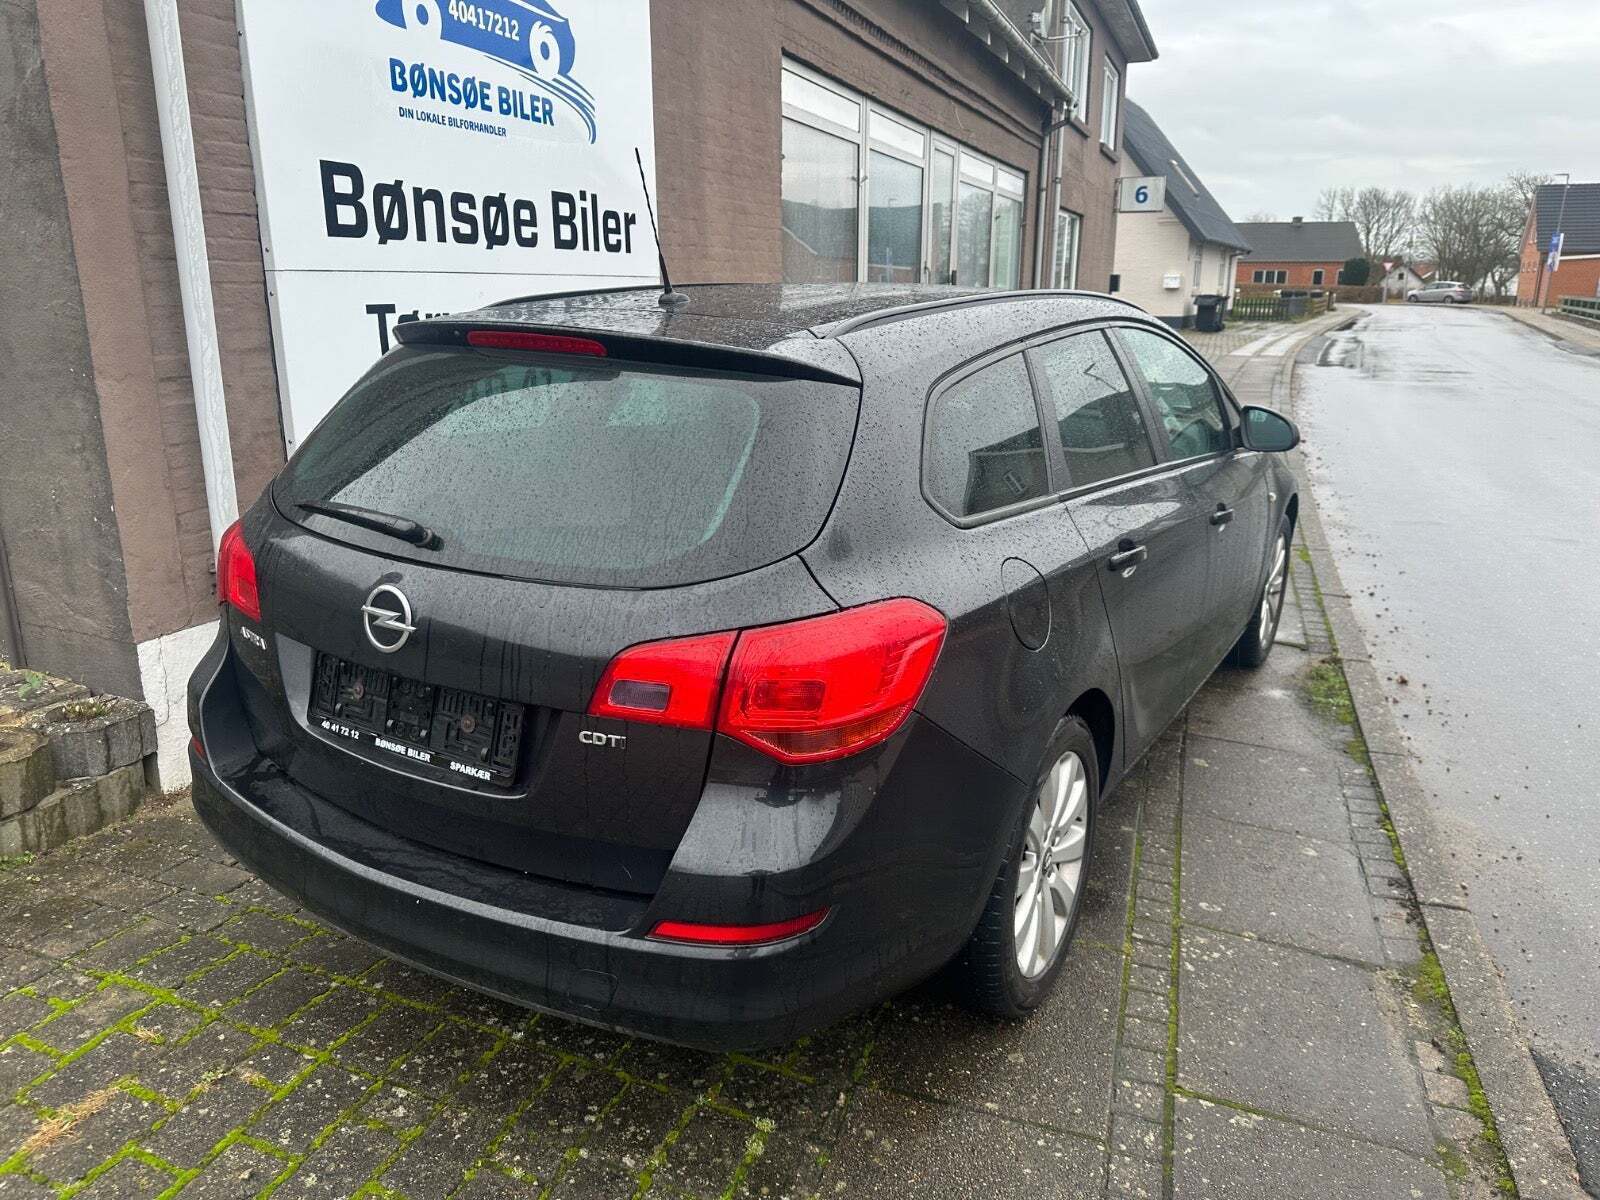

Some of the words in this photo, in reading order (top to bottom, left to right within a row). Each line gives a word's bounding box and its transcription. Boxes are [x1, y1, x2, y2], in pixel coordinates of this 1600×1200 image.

[448, 0, 520, 41] 40417212
[389, 57, 493, 110] BØNSØE
[497, 86, 555, 126] BILER
[398, 106, 414, 119] DIN
[415, 110, 447, 126] LOKALE
[448, 116, 507, 137] BILFORHANDLER
[319, 159, 539, 250] Bønsøe
[551, 190, 637, 254] Biler
[1135, 185, 1149, 204] 6
[331, 723, 340, 733] 41
[340, 726, 349, 736] 72
[350, 729, 359, 740] 12
[375, 738, 406, 755] BØNSØE
[407, 748, 431, 763] BILER
[450, 761, 491, 781] SPARKÆR
